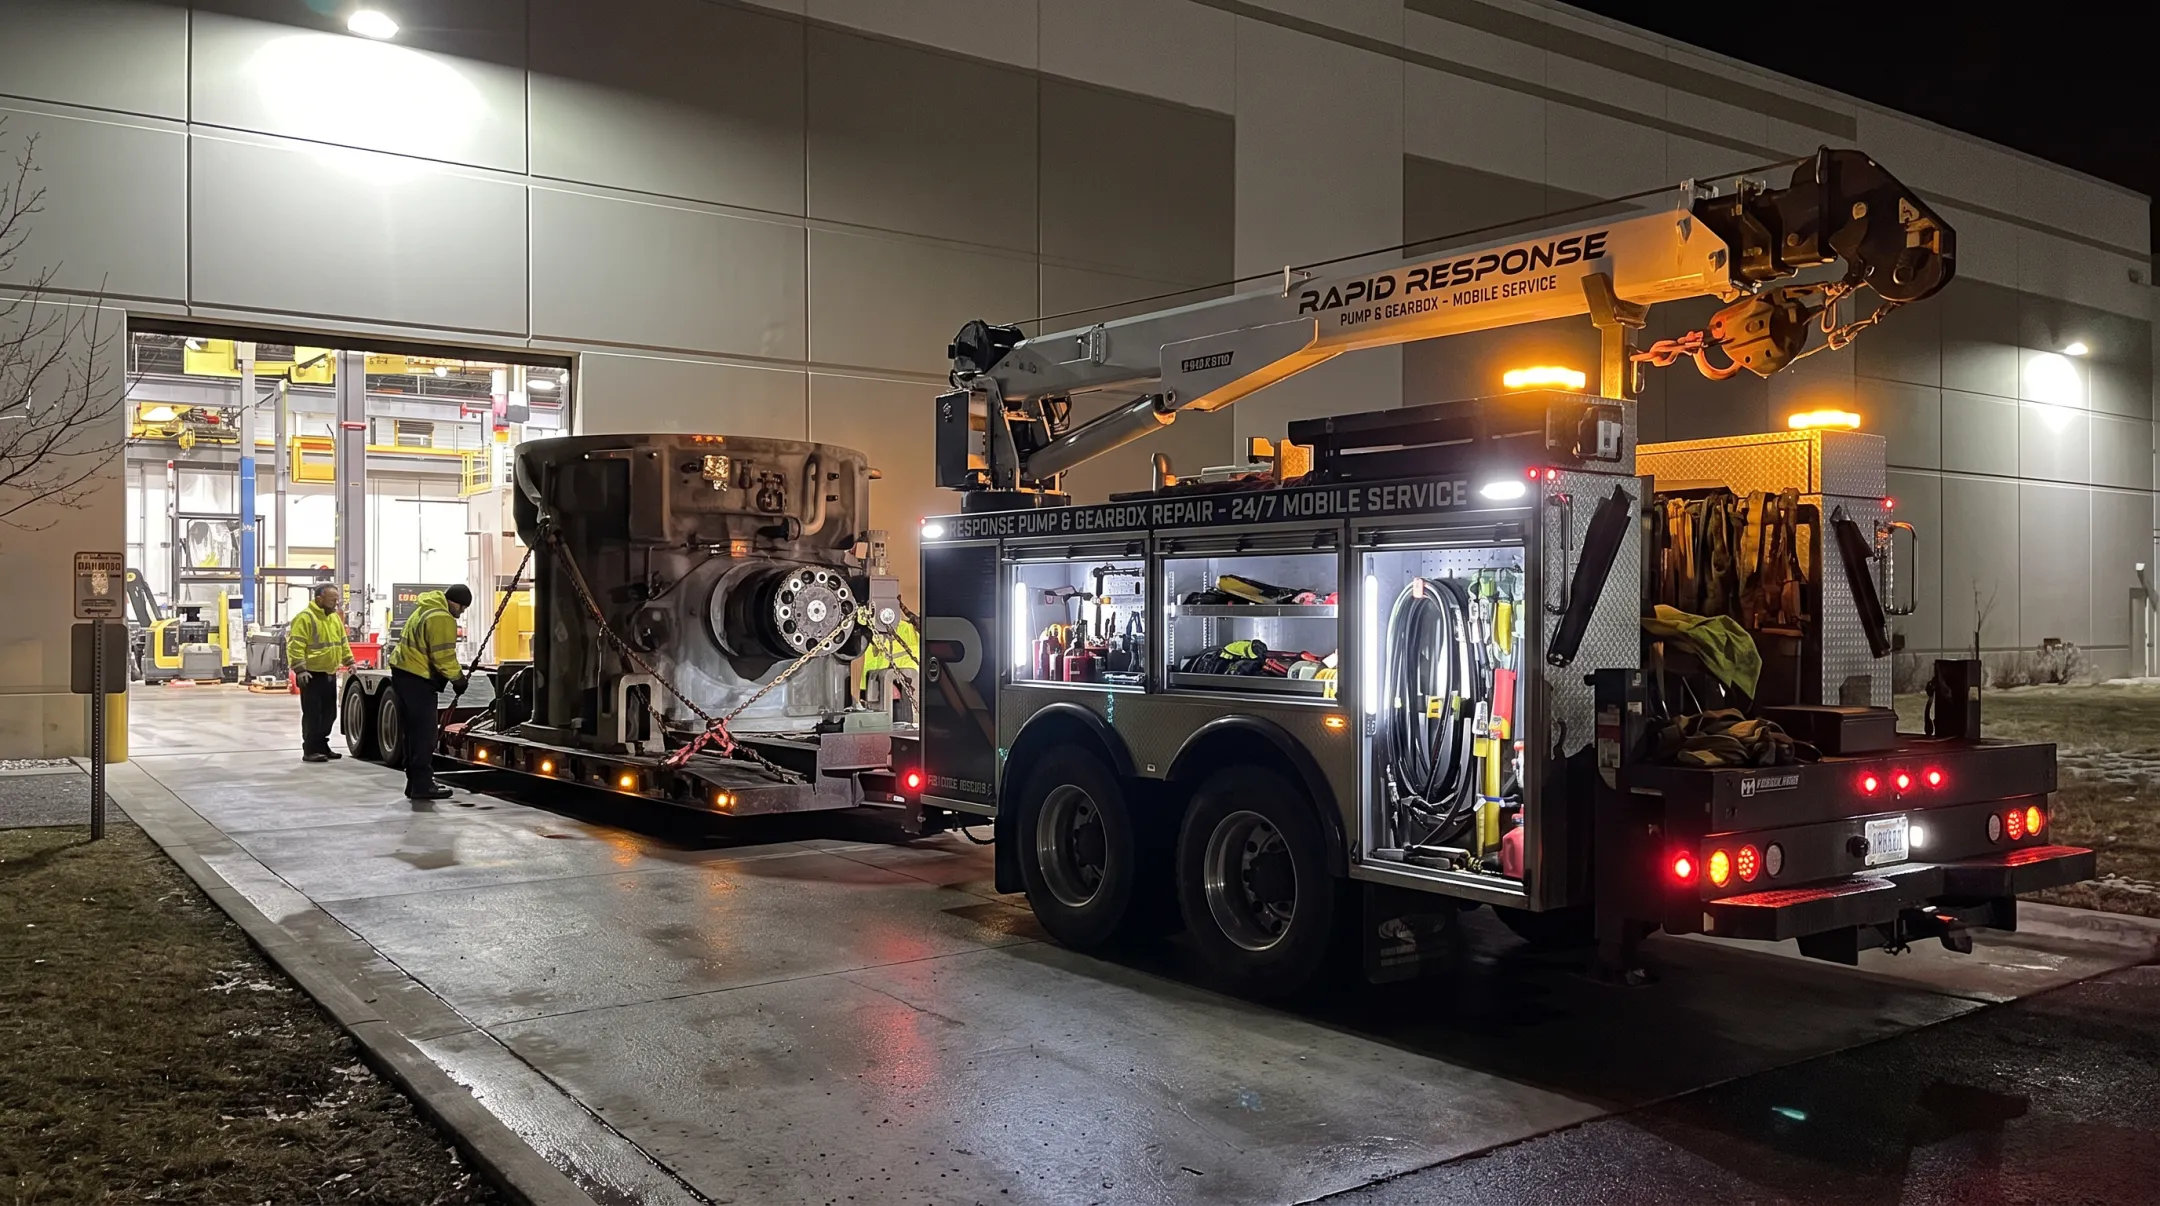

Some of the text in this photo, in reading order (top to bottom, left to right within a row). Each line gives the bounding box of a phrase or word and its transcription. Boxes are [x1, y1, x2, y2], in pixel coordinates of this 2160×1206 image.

[1299, 231, 1609, 315] RAPID RESPONSE
[1340, 308, 1372, 326] PUMP
[1374, 306, 1382, 320] &
[1385, 296, 1439, 319] GEARBOX
[1453, 285, 1498, 306] MOBILE
[1502, 275, 1557, 298] SERVICE
[949, 515, 1015, 538] RESPONSE
[1018, 512, 1057, 533] PUMP
[1061, 511, 1071, 531] &
[1075, 505, 1147, 530] GEARBOX
[1152, 500, 1213, 525] REPAIR
[1231, 495, 1277, 521] 24/7
[1283, 488, 1361, 517] MOBILE
[1367, 480, 1467, 511] SERVICE
